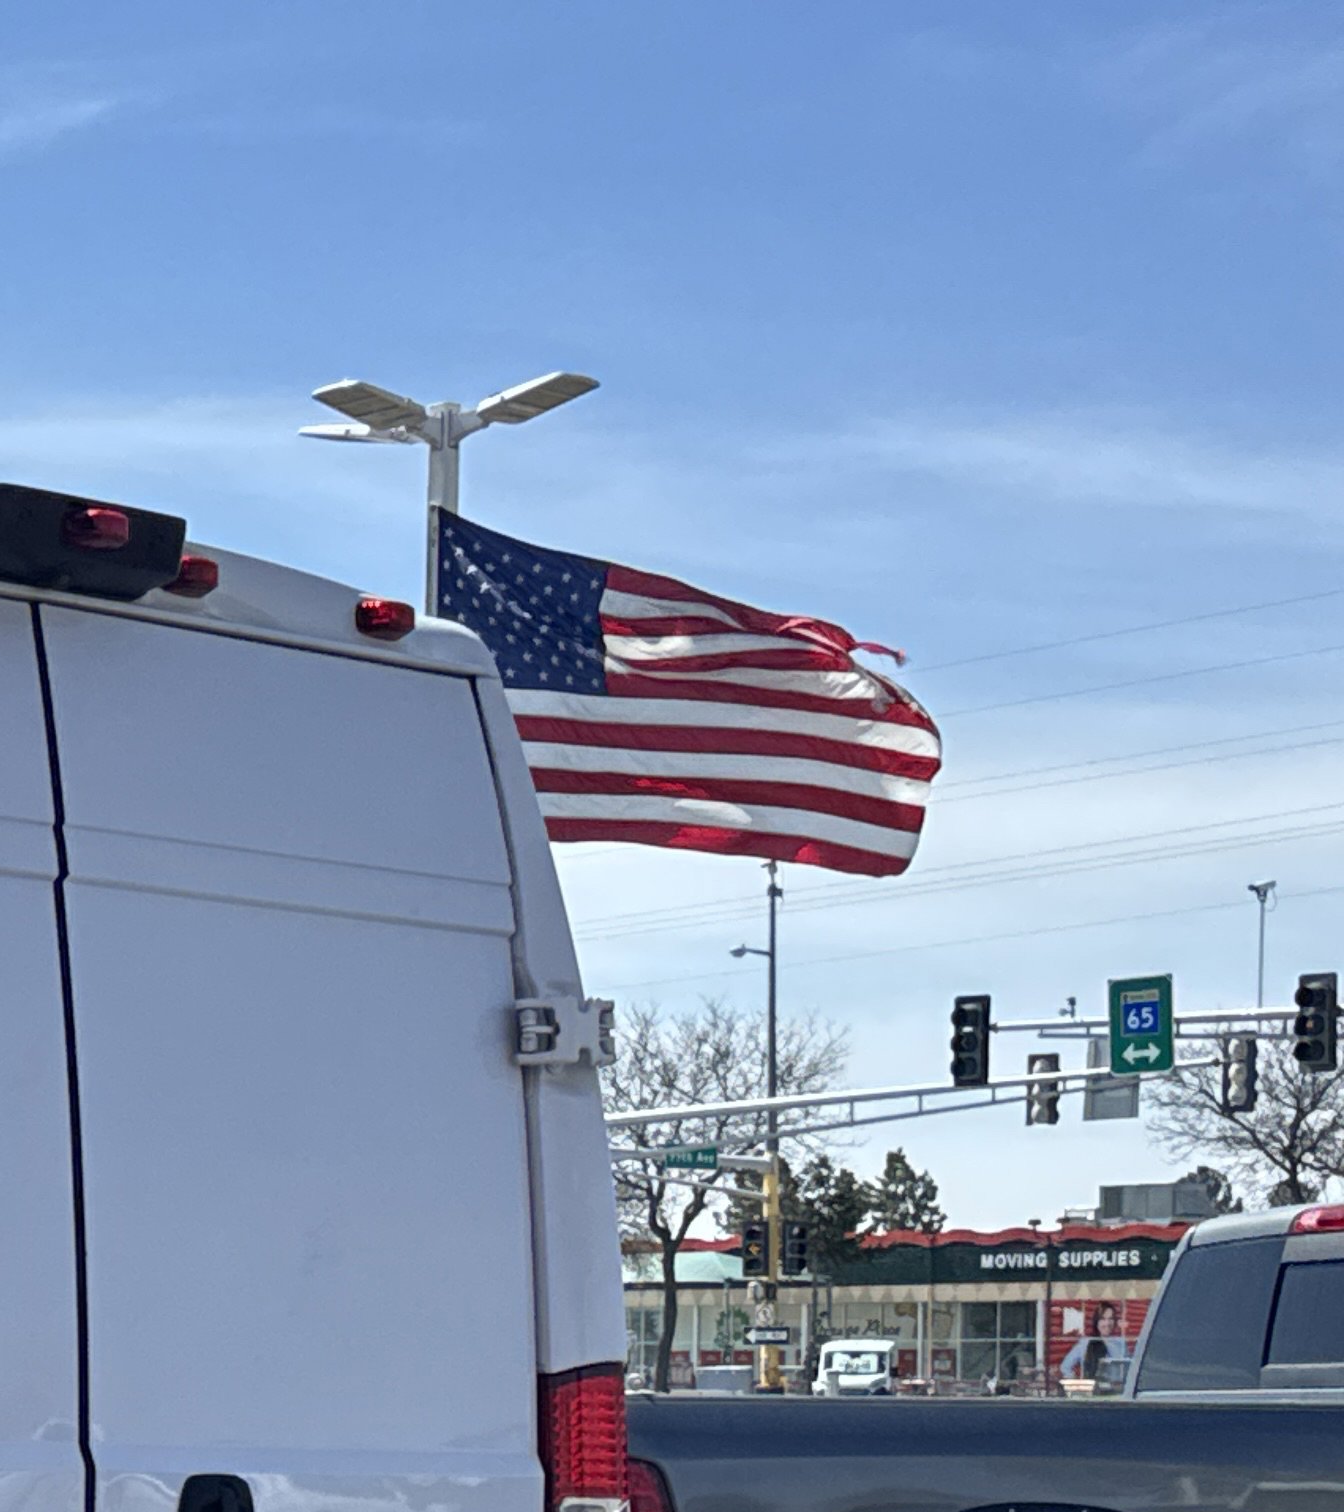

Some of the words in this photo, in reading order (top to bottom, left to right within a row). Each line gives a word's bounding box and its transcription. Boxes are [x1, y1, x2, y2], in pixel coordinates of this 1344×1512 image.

[1127, 1006, 1154, 1030] 65
[980, 1251, 1048, 1269] MOVING
[1058, 1250, 1140, 1267] SUPPLIES
